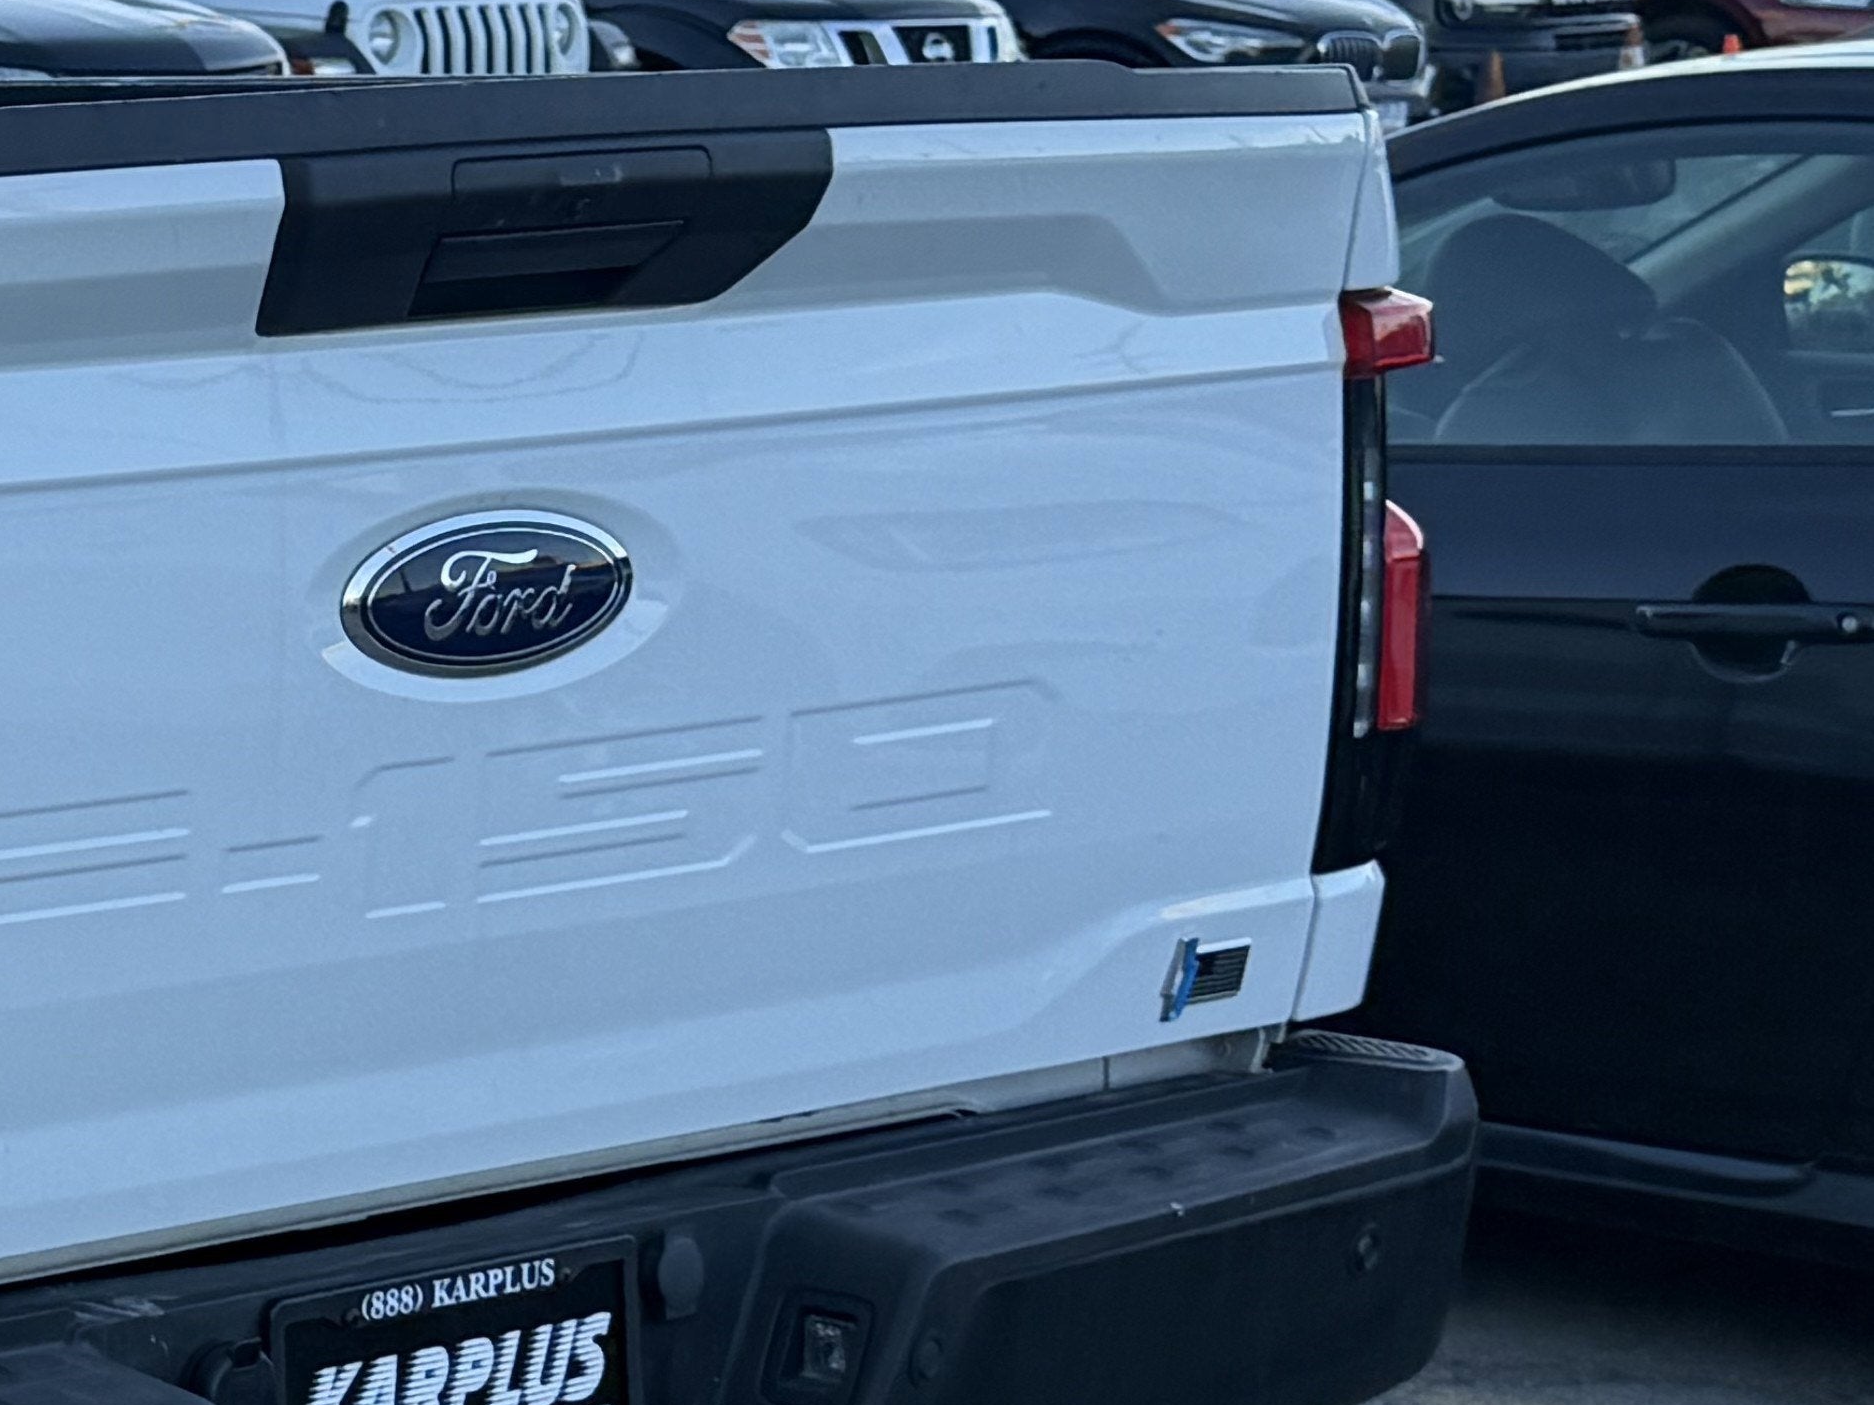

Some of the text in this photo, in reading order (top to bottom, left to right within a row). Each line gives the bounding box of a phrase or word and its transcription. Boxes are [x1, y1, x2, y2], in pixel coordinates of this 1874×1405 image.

[423, 548, 577, 642] Ford
[360, 1258, 556, 1321] (888) KARPLUS
